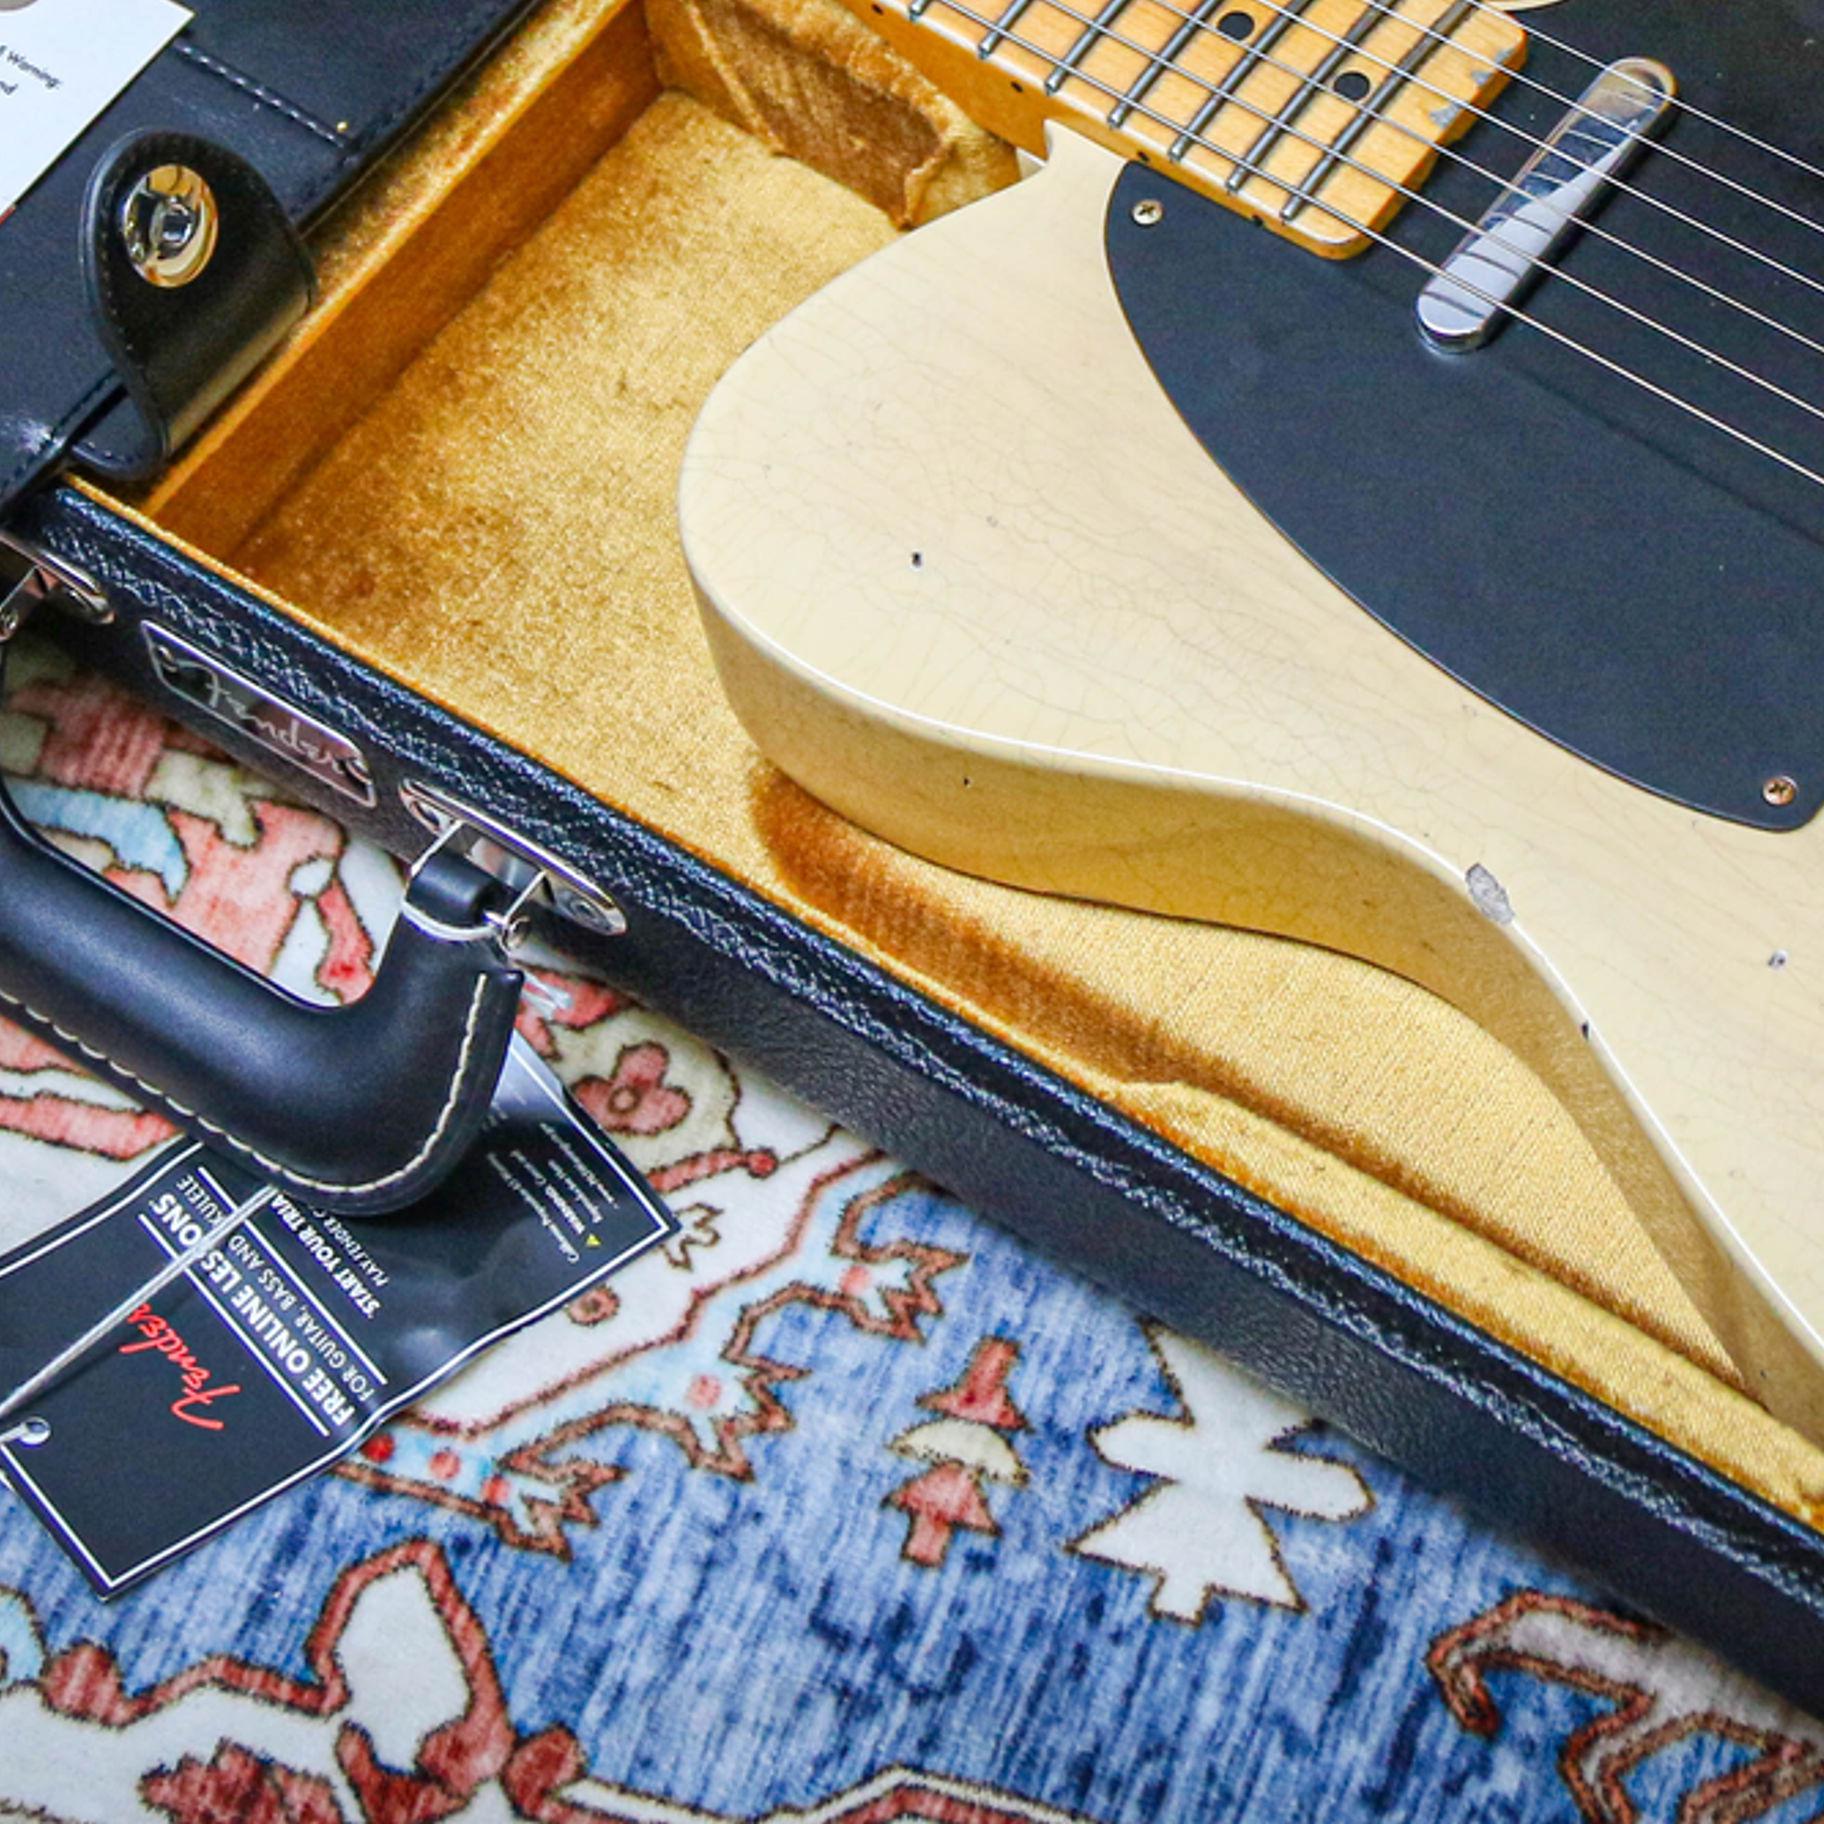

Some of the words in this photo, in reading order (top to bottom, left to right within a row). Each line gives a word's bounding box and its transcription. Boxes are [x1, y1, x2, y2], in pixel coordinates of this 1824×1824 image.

[0, 50, 66, 92] Warning:
[176, 658, 345, 776] Fender
[177, 1171, 228, 1228] KULELE
[268, 1189, 307, 1231] TRIA
[150, 1189, 243, 1293] LESONS
[227, 1229, 266, 1272] AND
[297, 1222, 343, 1271] YOUR
[257, 1264, 298, 1310] BASS
[332, 1262, 382, 1317] START
[228, 1279, 315, 1376] ONLINE
[291, 1301, 352, 1370] GUITAR,
[119, 1302, 241, 1432] Fender
[340, 1362, 376, 1402] FOR
[299, 1364, 358, 1427] FREE
